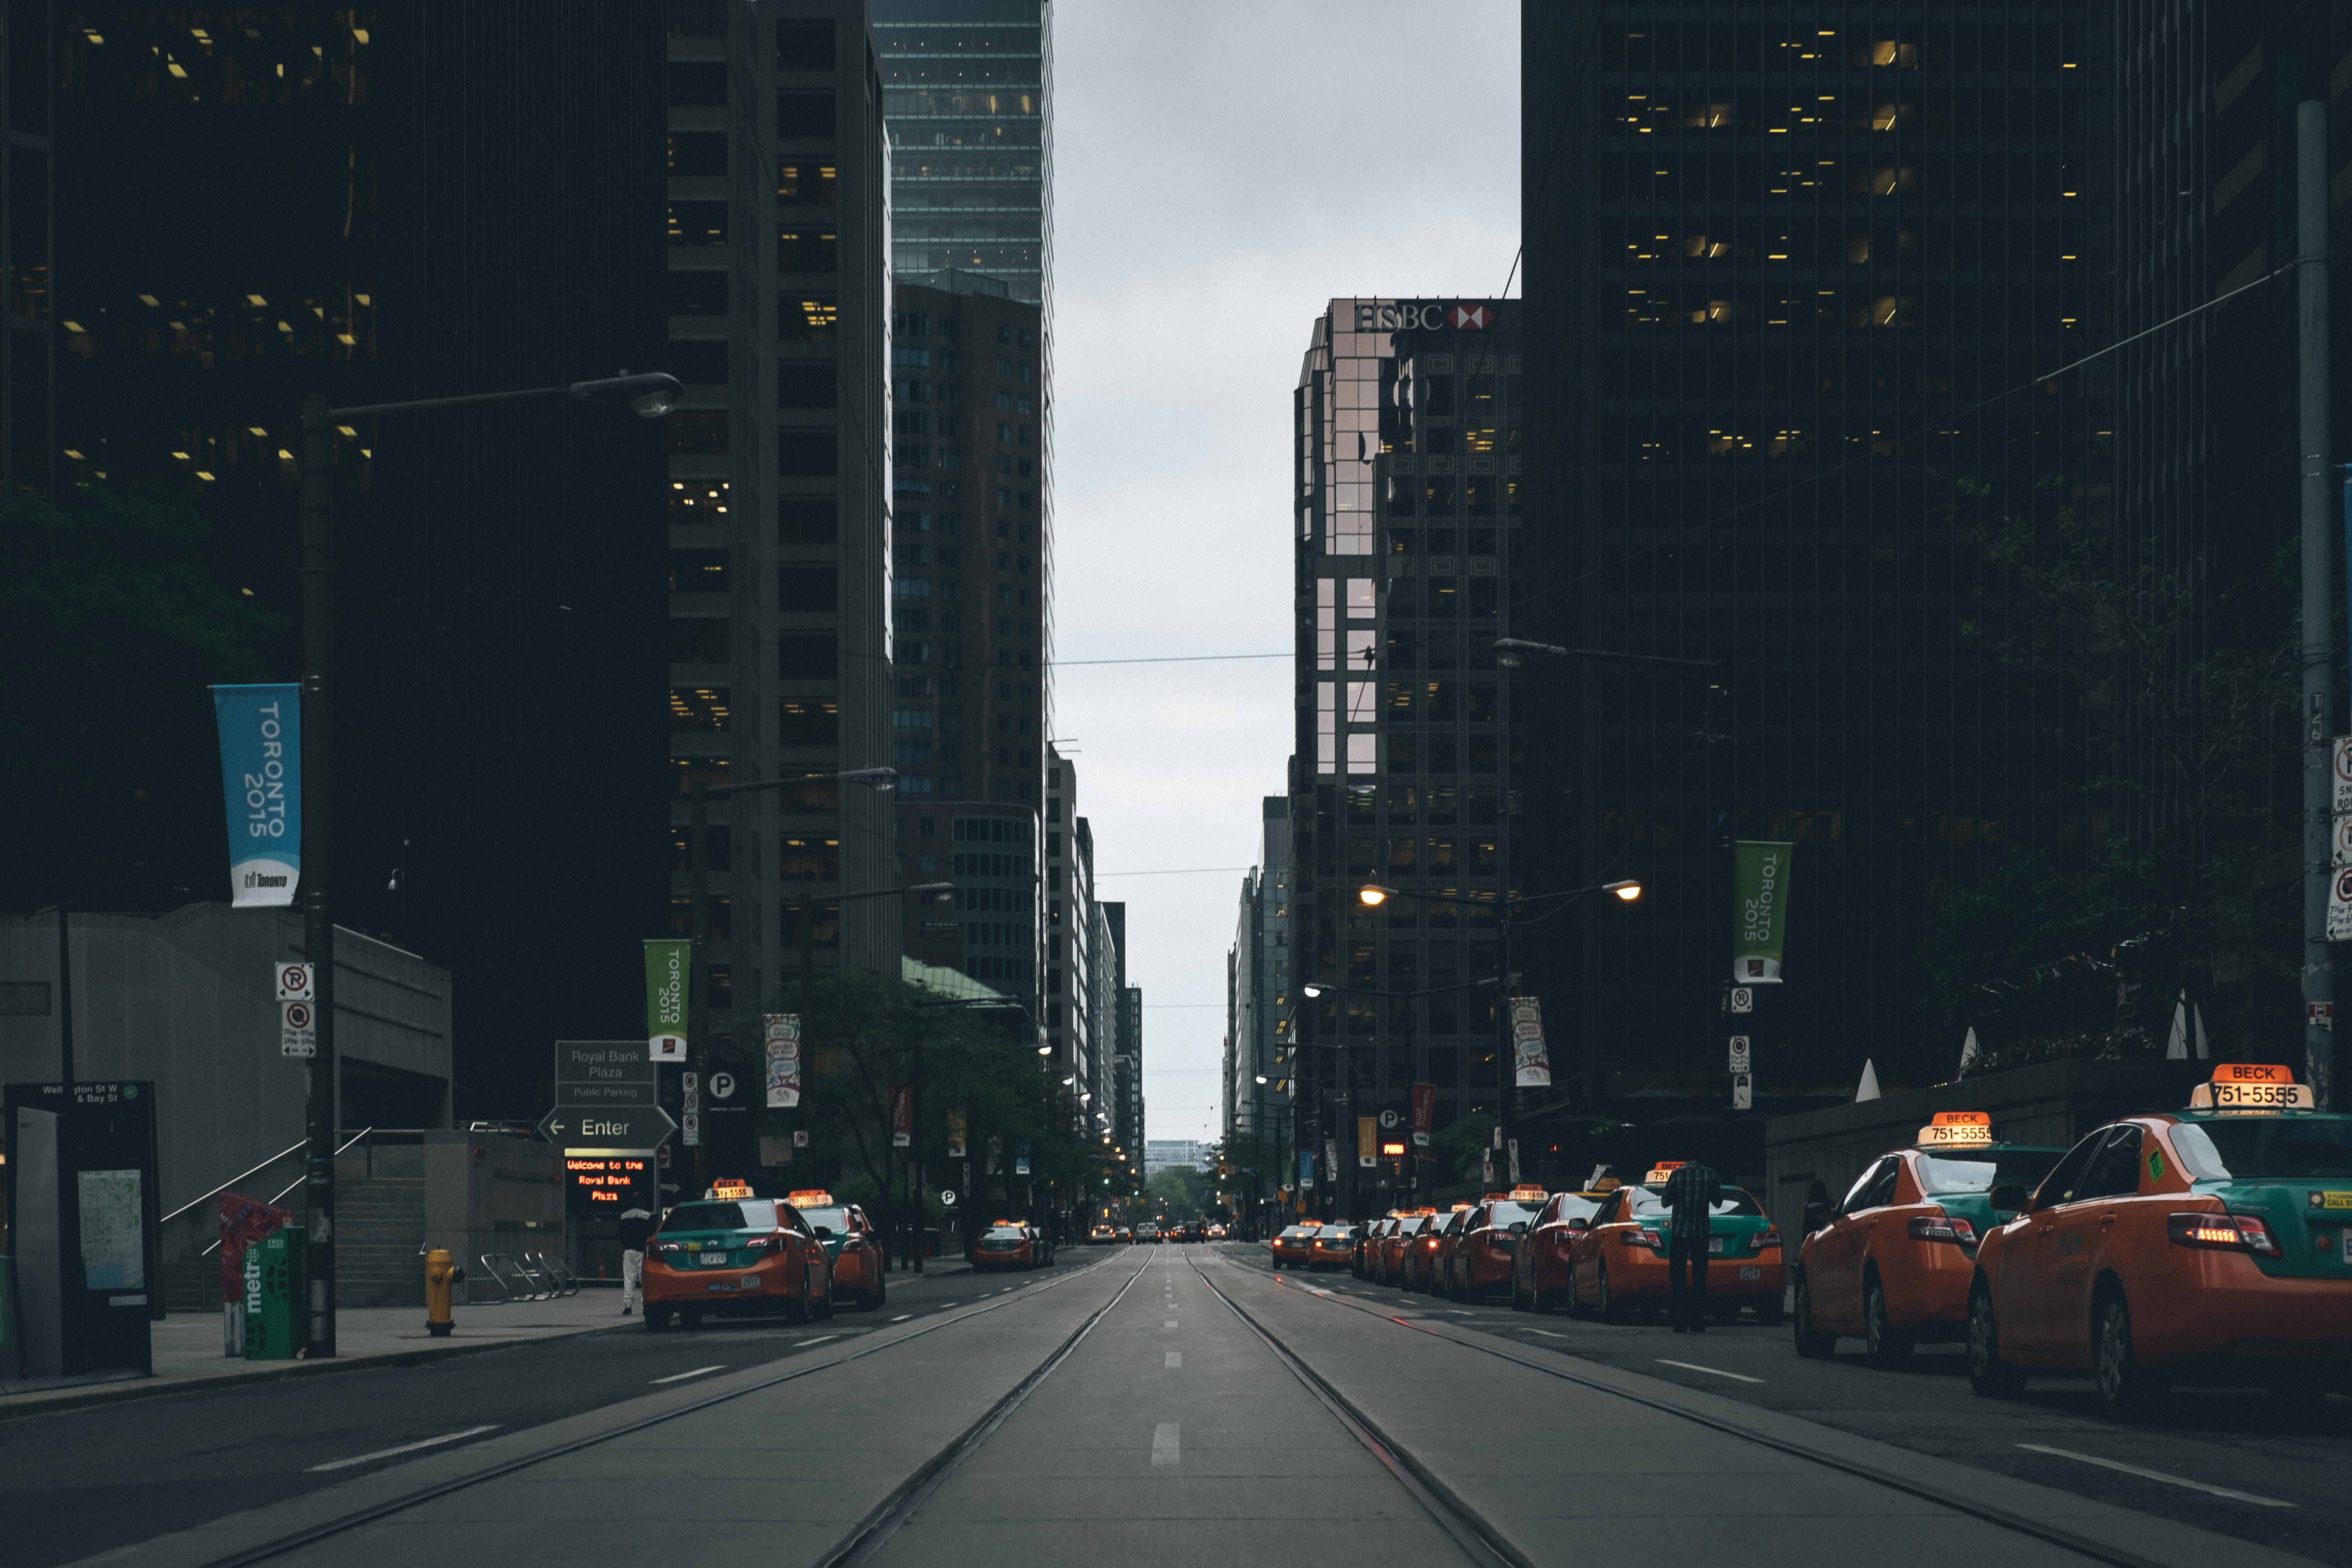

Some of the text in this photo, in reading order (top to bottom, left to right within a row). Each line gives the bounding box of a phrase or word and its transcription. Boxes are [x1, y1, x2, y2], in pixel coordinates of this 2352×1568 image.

[1355, 304, 1443, 330] HSBC
[259, 701, 285, 838] TORONTO
[2340, 785, 2352, 796] SN
[244, 773, 267, 838] 2015
[2338, 798, 2352, 809] RO
[257, 873, 287, 888] TORONTO
[1757, 853, 1777, 941] TORONTO
[1744, 899, 1758, 941] 2015
[669, 949, 680, 1024] TORONTO
[659, 987, 670, 1024] 2015
[572, 1050, 639, 1064] Royal Bank
[589, 1067, 622, 1078] Plaza
[2233, 1067, 2275, 1080] BECK
[43, 1084, 118, 1096] Wellton St W
[716, 1076, 731, 1094] P
[77, 1093, 118, 1104] & Bay St
[574, 1087, 638, 1099] Public Parking
[2214, 1085, 2298, 1104] 751-5555
[1947, 1115, 1977, 1124] BECK
[582, 1119, 630, 1135] Enter
[1932, 1128, 1991, 1139] 751-5555
[567, 1160, 644, 1170] Welcome to the
[578, 1175, 631, 1185] Royal Bank
[592, 1190, 618, 1201] Plaza
[945, 1192, 953, 1202] P
